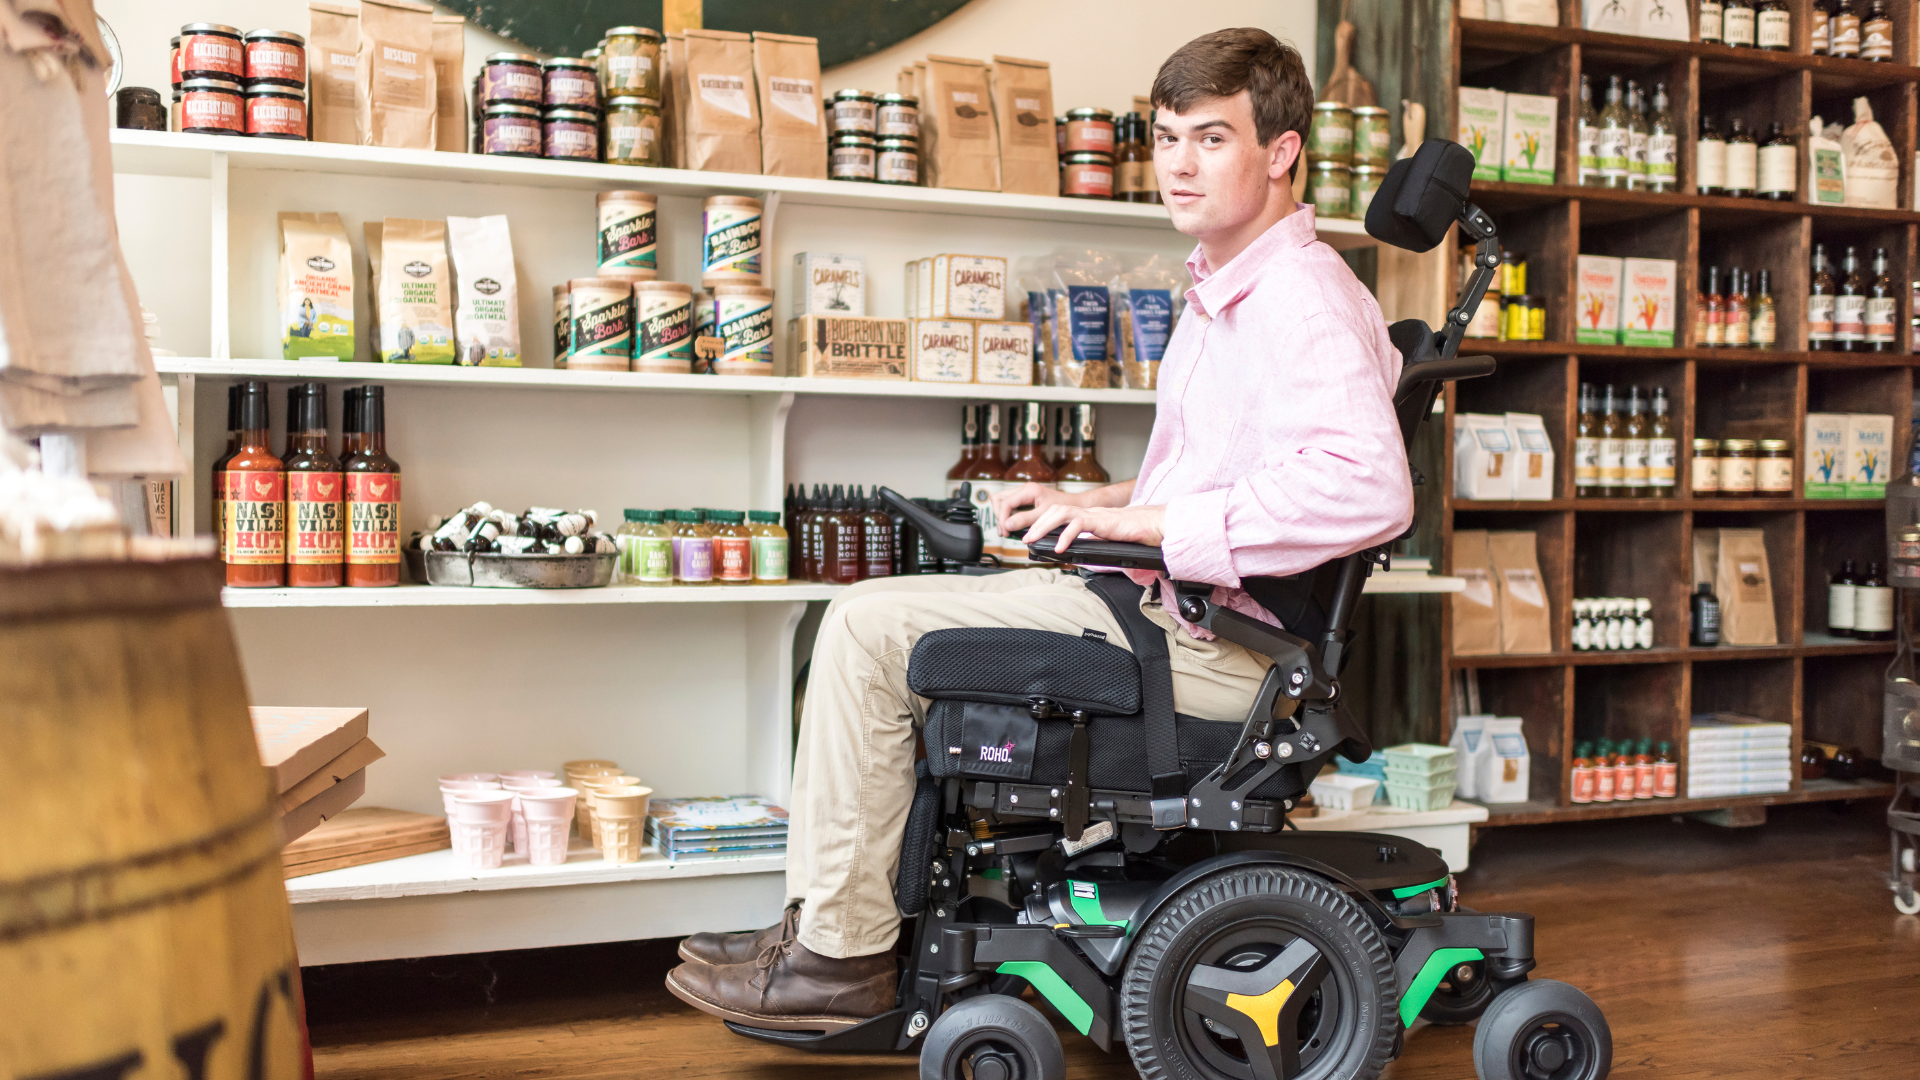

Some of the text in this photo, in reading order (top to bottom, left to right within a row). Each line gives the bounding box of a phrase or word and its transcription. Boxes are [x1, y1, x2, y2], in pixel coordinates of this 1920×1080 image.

[193, 43, 229, 59] BLACKBERRY
[250, 50, 283, 66] BLACKBERRY
[383, 46, 417, 65] BISCUIT
[330, 52, 356, 67] BISCU
[186, 100, 221, 115] BLACKBERRY
[253, 105, 288, 121] BLACKBERRY
[607, 217, 651, 245] Sparkle
[710, 220, 760, 246] RAINBOW
[618, 231, 649, 252] Bark
[729, 236, 758, 255] Bark
[294, 279, 351, 292] ANCIENT GRAIN
[305, 274, 338, 283] ORGANIC
[813, 268, 859, 288] CARAMELS
[954, 269, 1001, 290] CARAMELS
[305, 287, 339, 297] OATMEAL
[474, 313, 507, 321] OATMEAL
[581, 303, 626, 332] Sparkle
[648, 306, 689, 333] Sparkle
[723, 310, 772, 338] RAINBOW
[593, 319, 624, 340] Bark
[660, 321, 688, 343] Bark
[742, 325, 769, 346] Bark
[831, 319, 906, 344] BOURBON NIB
[831, 342, 906, 360] BRITTLE
[922, 333, 969, 353] CARAMELS
[982, 336, 1028, 356] CARAMELS
[1817, 430, 1842, 440] MAPLE
[1859, 430, 1884, 441] MAPLE
[236, 502, 283, 518] NASH
[298, 502, 343, 519] NASH
[352, 503, 397, 519] NASH
[236, 519, 283, 531] VILLE
[298, 520, 342, 531] VILLE
[352, 520, 397, 531] VILLE
[838, 526, 858, 534] BEE
[865, 526, 891, 534] BEES
[236, 532, 283, 548] HOT
[299, 532, 342, 548] HOT
[353, 532, 397, 548] HOT
[838, 543, 858, 551] SPIC
[865, 543, 891, 551] SPICY
[649, 551, 666, 559] BANG
[693, 551, 710, 560] BANG
[724, 550, 741, 559] BANG
[767, 550, 784, 559] BANG
[647, 559, 667, 569] CANDY
[691, 559, 711, 569] CANDY
[722, 558, 743, 568] CANDY
[765, 558, 785, 568] CANDY
[980, 746, 1009, 762] ROHO
[1072, 881, 1096, 899] M1
[1358, 1000, 1370, 1034] NYLON
